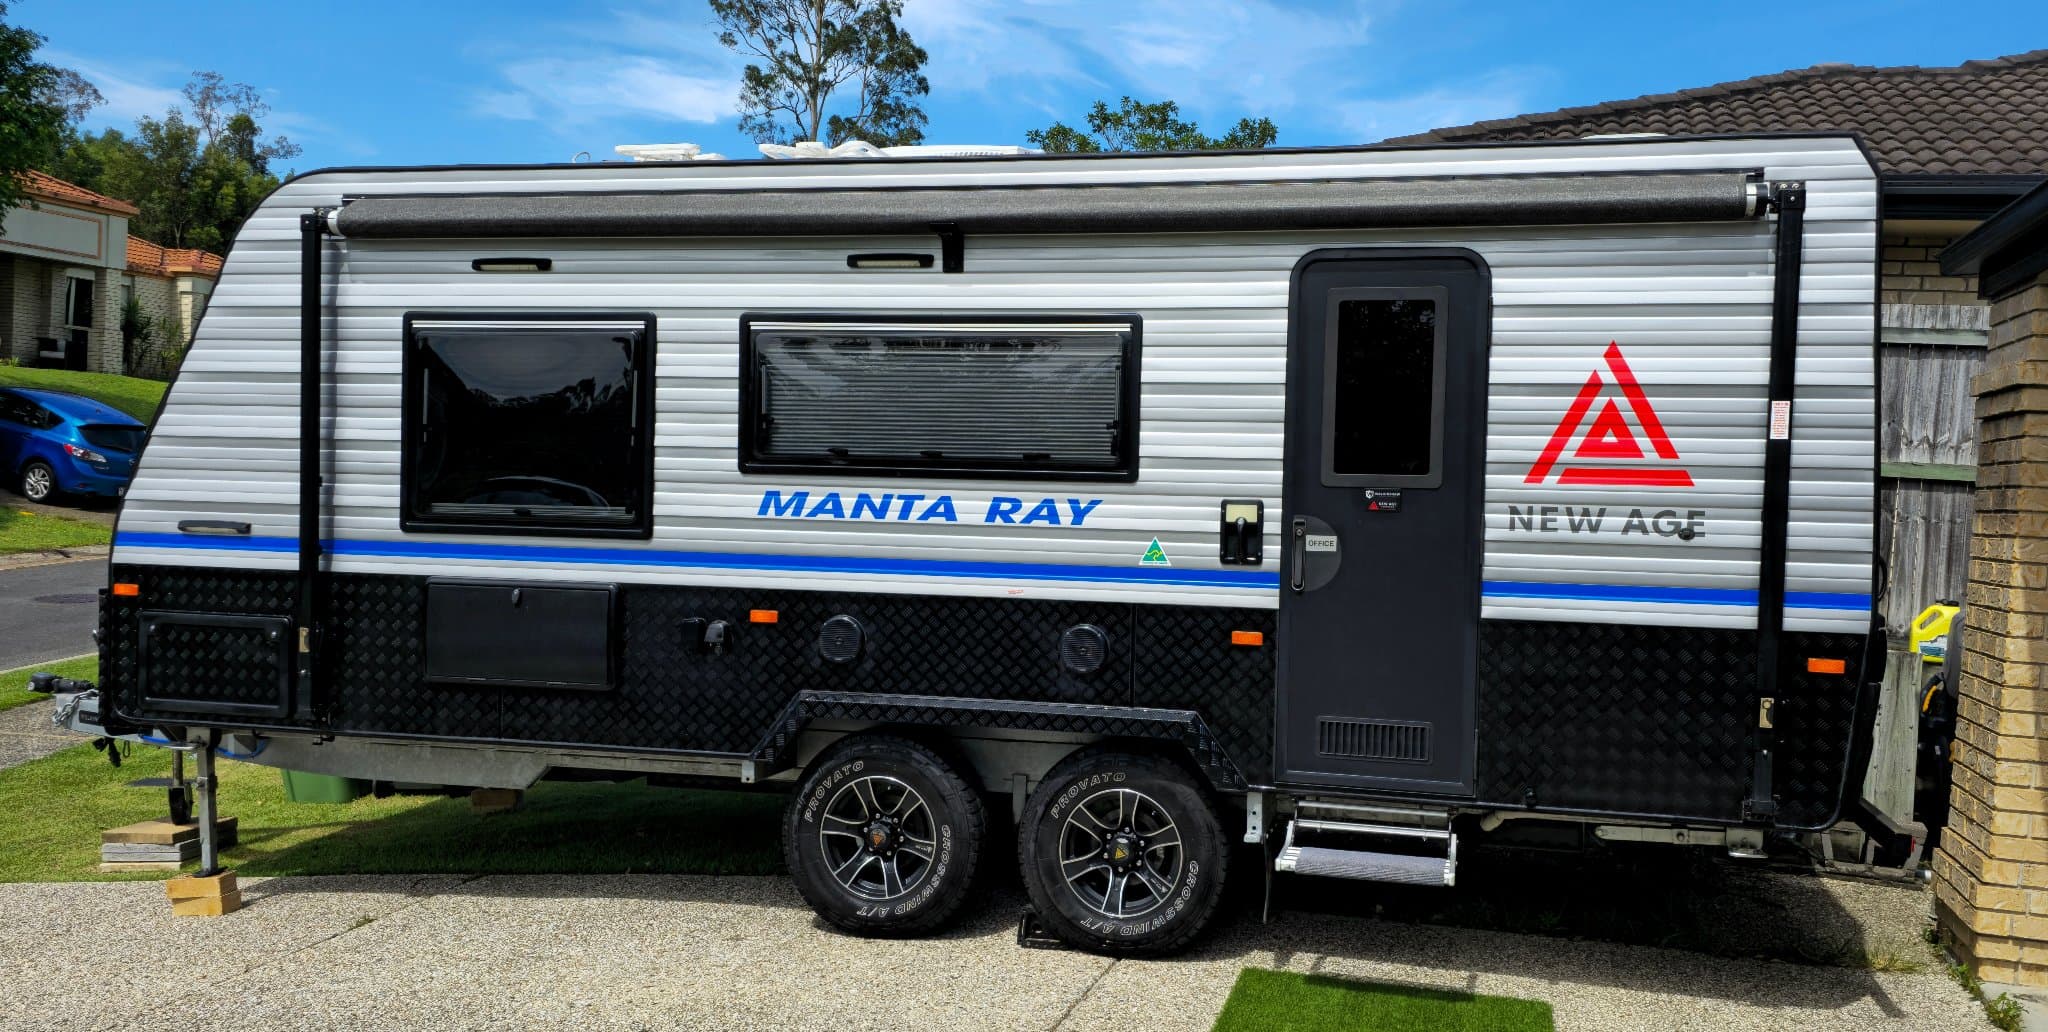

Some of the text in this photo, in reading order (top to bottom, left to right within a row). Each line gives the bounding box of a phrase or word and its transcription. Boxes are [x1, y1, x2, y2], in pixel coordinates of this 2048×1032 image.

[758, 490, 1103, 526] MANTA RAY
[1508, 505, 1706, 537] NEW AGE
[1308, 539, 1335, 547] OFFICE
[804, 760, 864, 822] PROVATO
[1051, 772, 1126, 819] PROVATO
[856, 824, 951, 917] CROSSWIND A/T
[1080, 860, 1199, 936] CROSSWIND A/T
